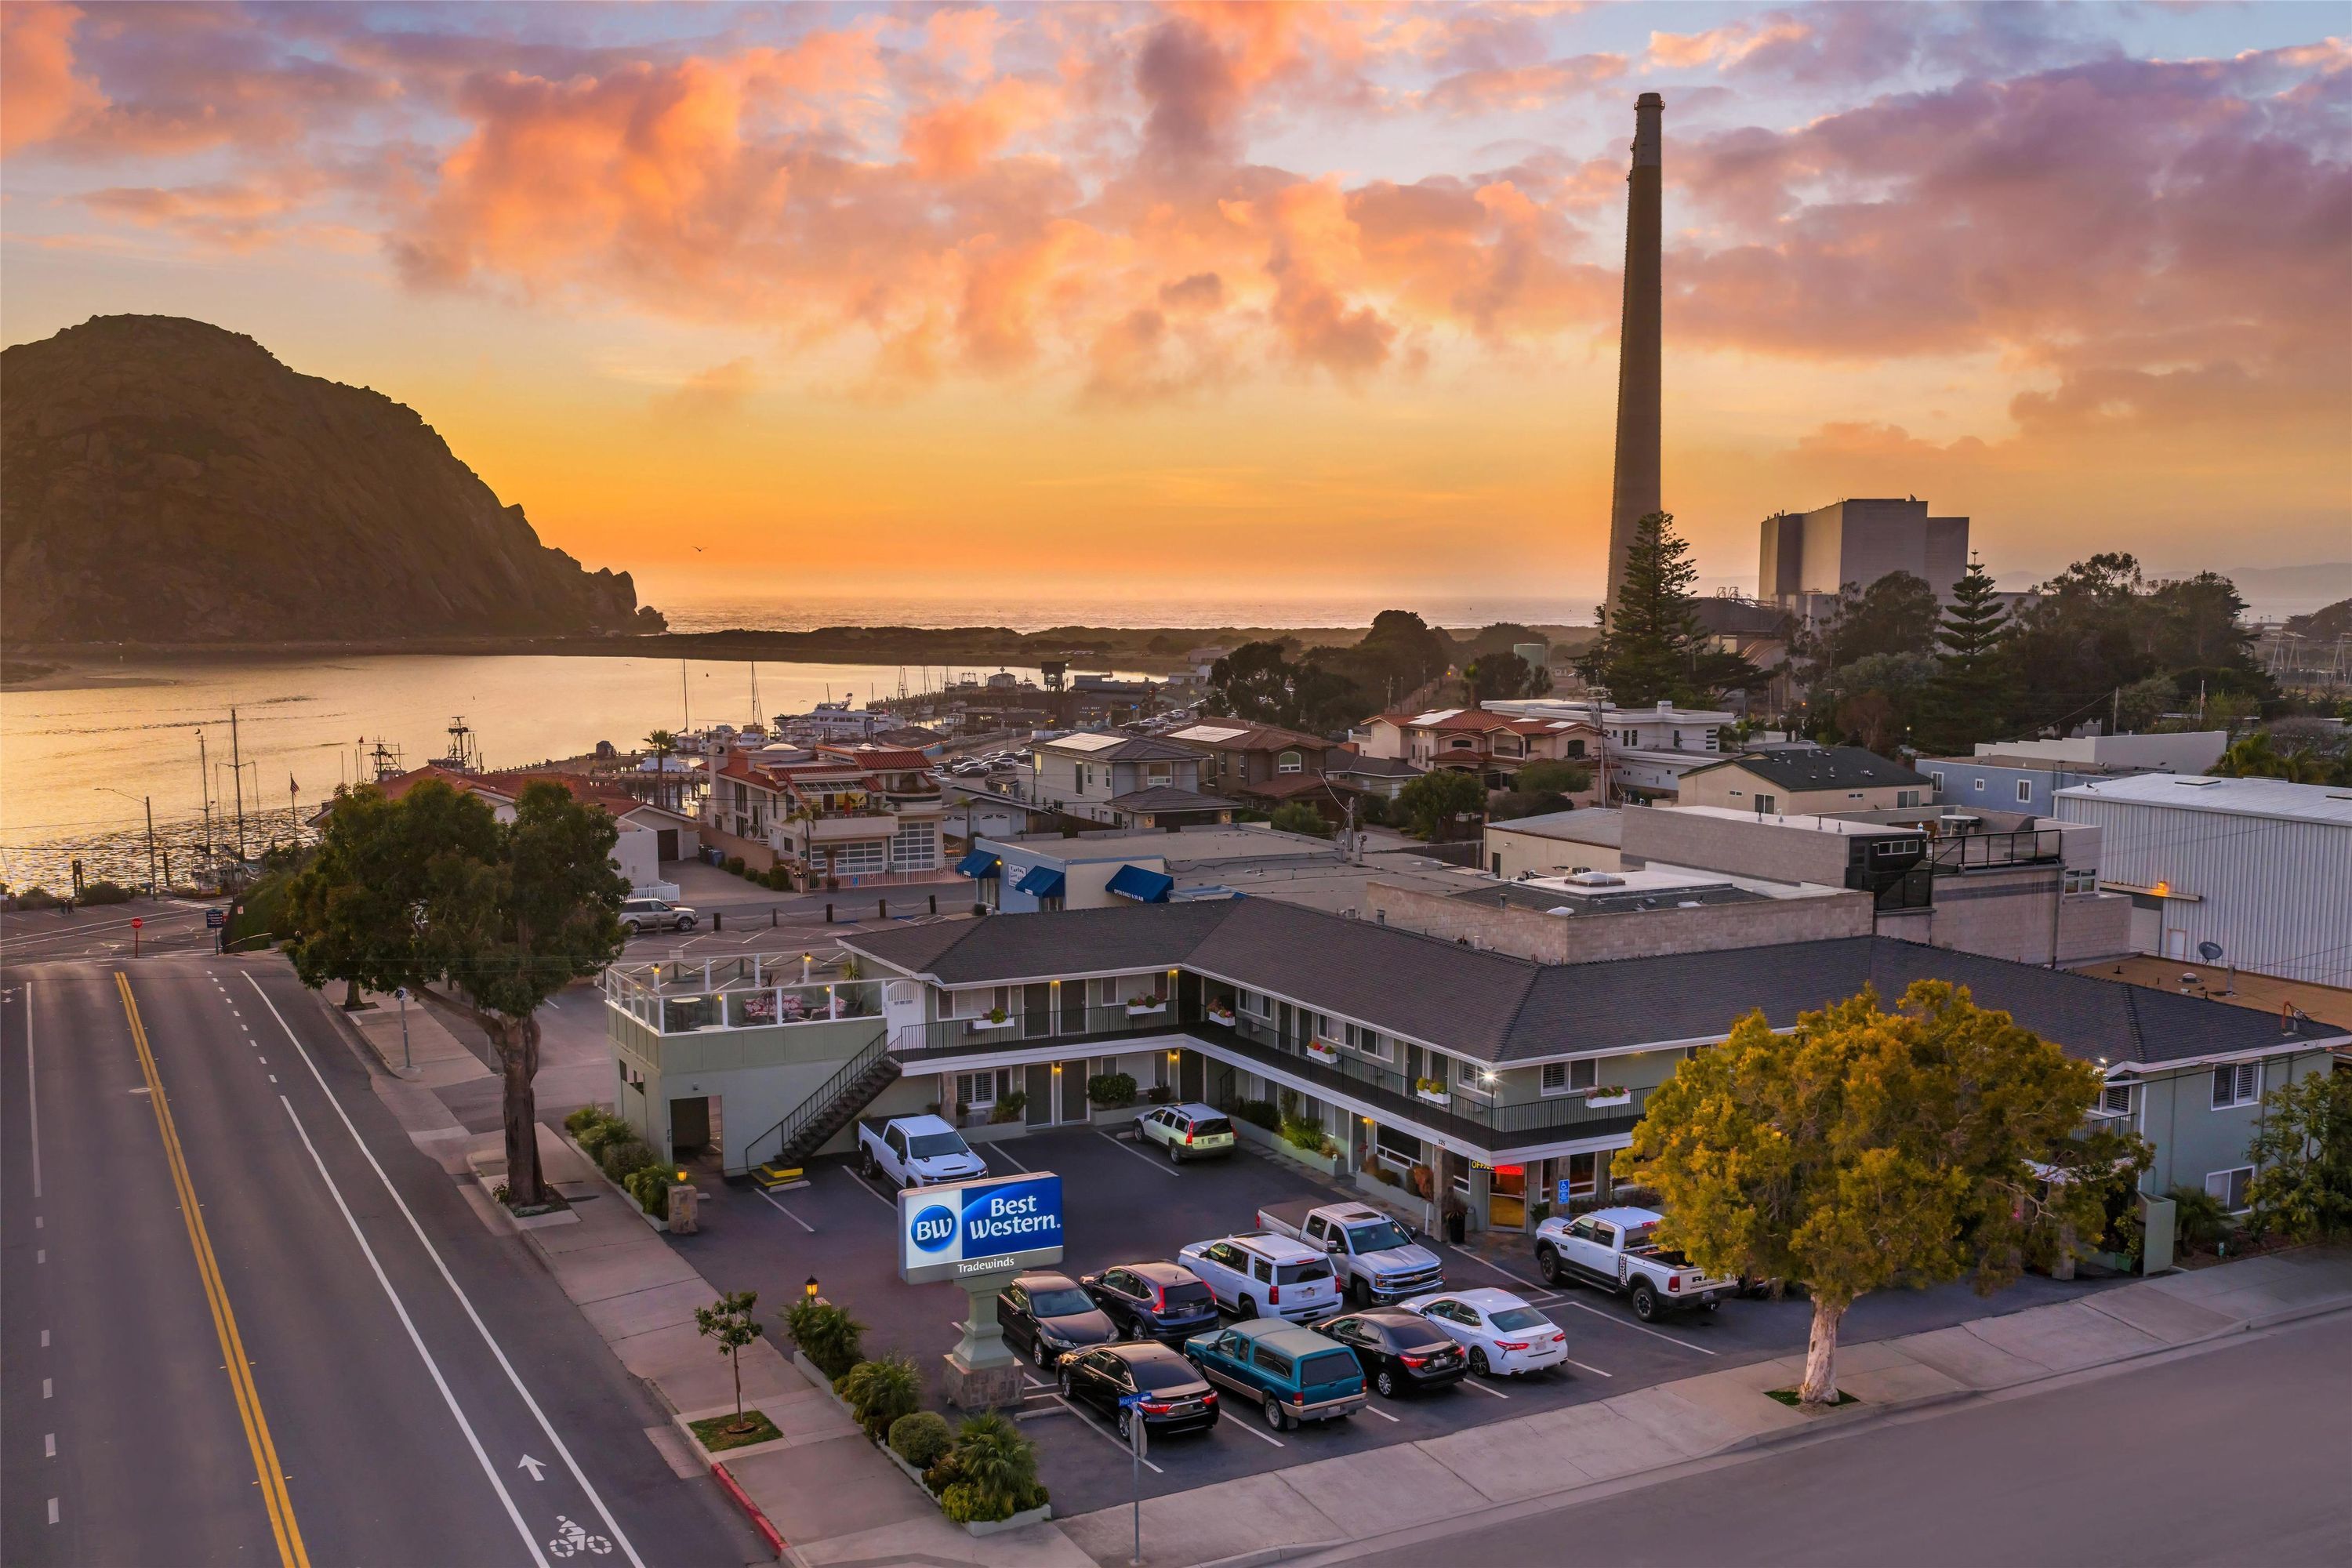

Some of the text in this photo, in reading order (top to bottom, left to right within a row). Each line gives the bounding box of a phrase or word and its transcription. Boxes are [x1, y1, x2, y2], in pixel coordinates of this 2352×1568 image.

[991, 1196, 1037, 1217] Best
[916, 1218, 953, 1241] BW
[957, 1257, 1014, 1273] Tradewinds
